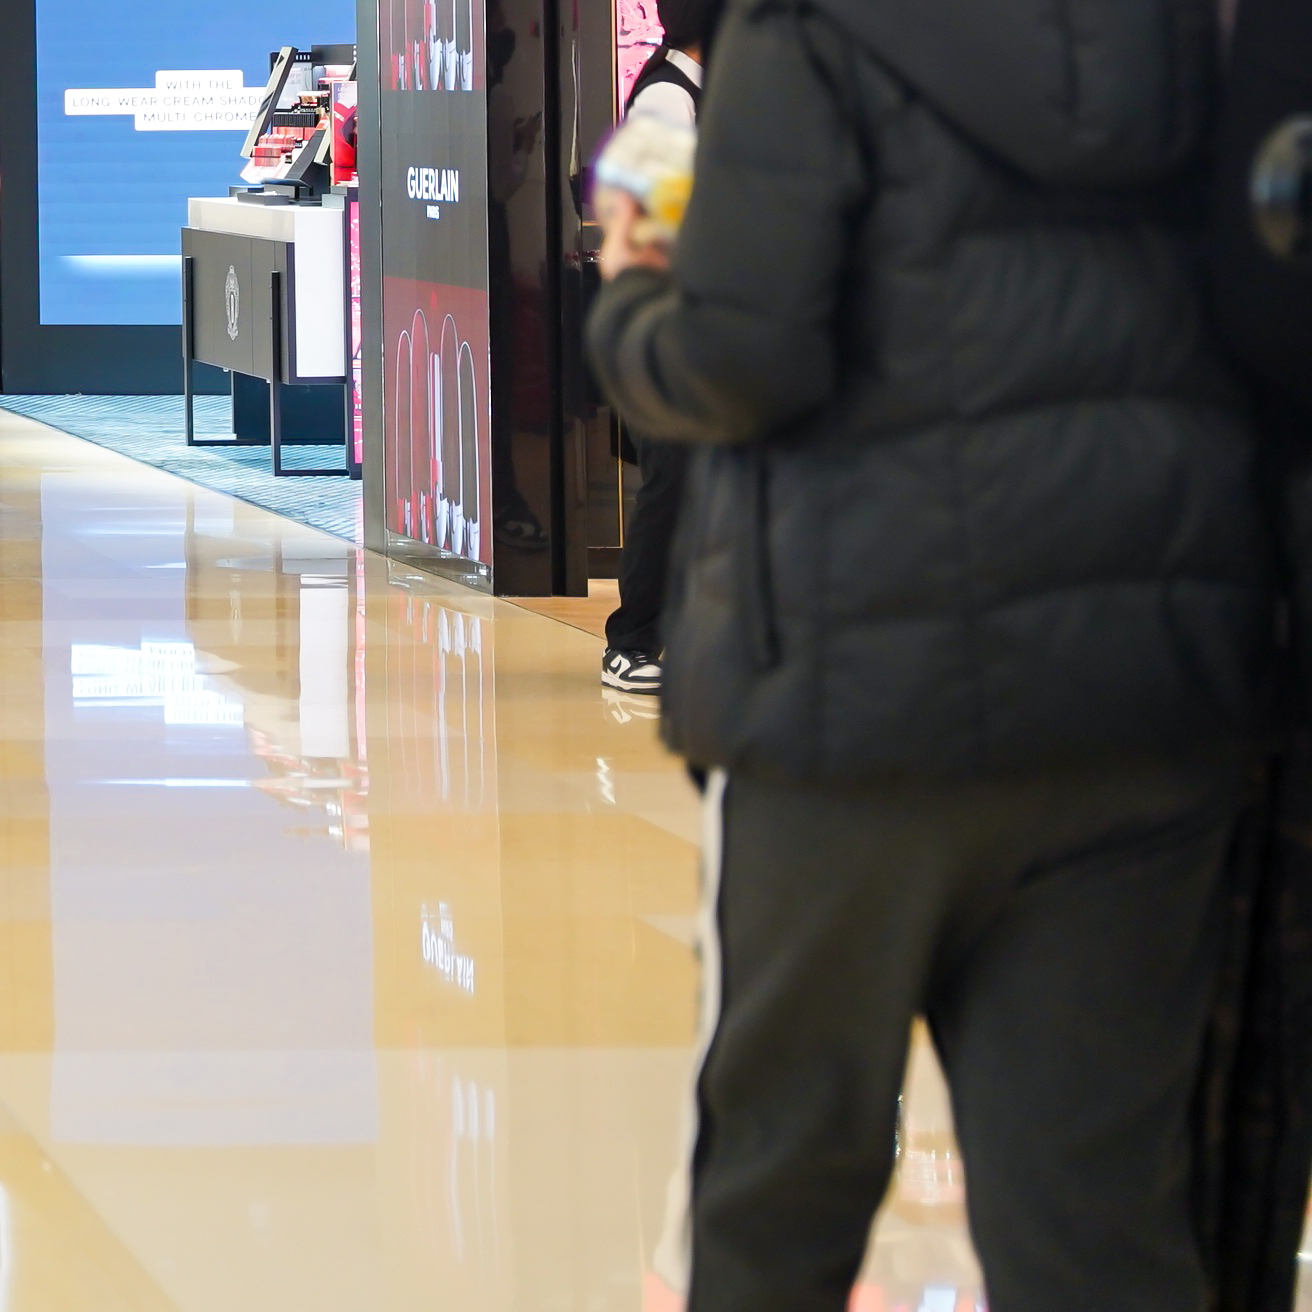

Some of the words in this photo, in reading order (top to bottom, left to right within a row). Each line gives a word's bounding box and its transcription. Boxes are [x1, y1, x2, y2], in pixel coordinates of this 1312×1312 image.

[166, 80, 201, 90] WITH
[208, 79, 233, 90] THE
[163, 95, 214, 106] CREAM
[407, 166, 459, 202] GUERLAIN
